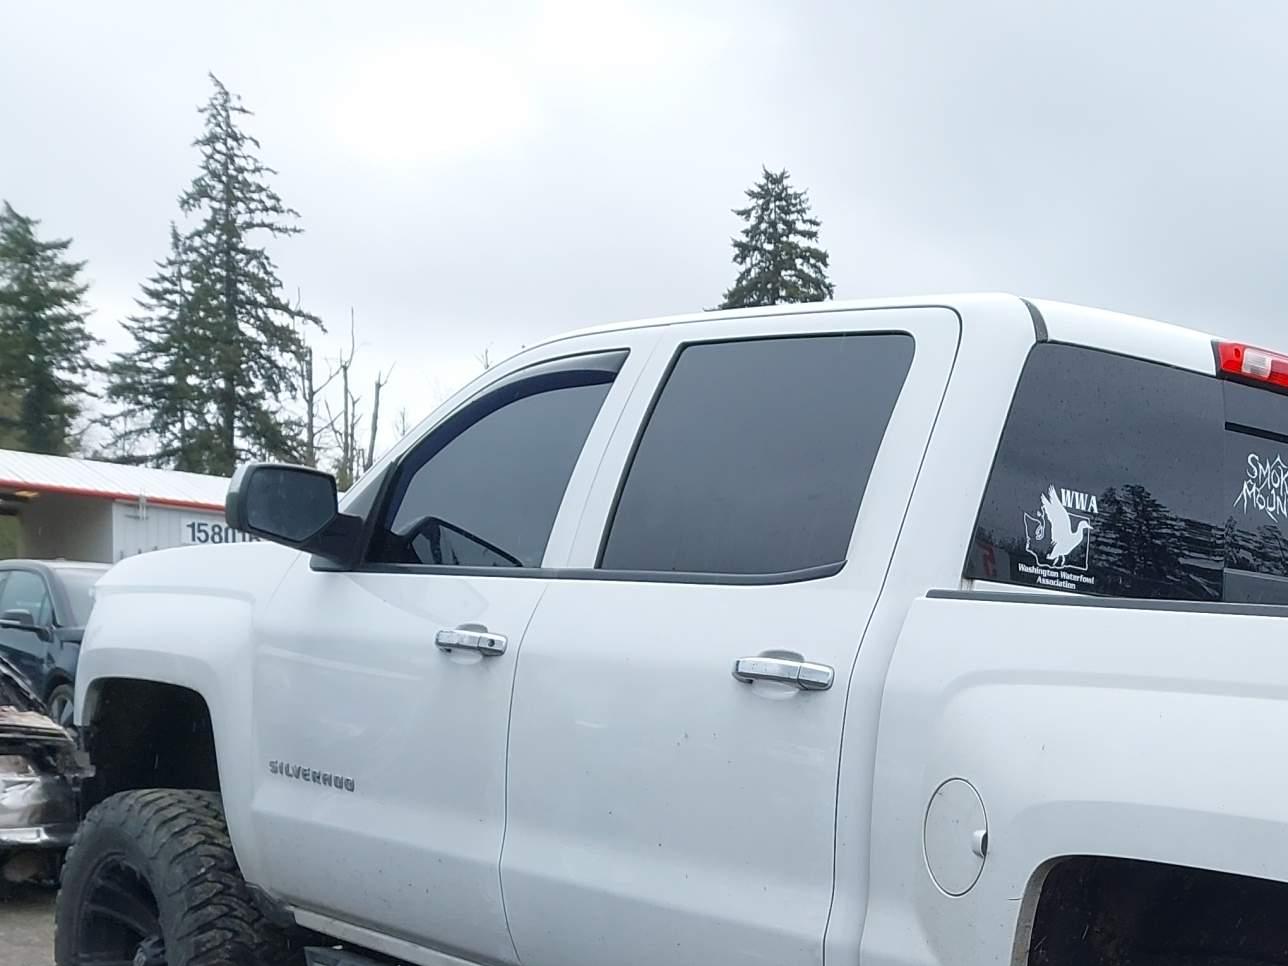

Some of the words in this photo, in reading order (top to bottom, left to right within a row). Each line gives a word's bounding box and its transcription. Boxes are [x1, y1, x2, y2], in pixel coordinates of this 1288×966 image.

[1060, 488, 1099, 514] WWA
[1018, 562, 1059, 578] Washington
[1060, 570, 1095, 585] Waterfowl
[1036, 575, 1076, 590] Association
[268, 759, 356, 793] SILVERADO
